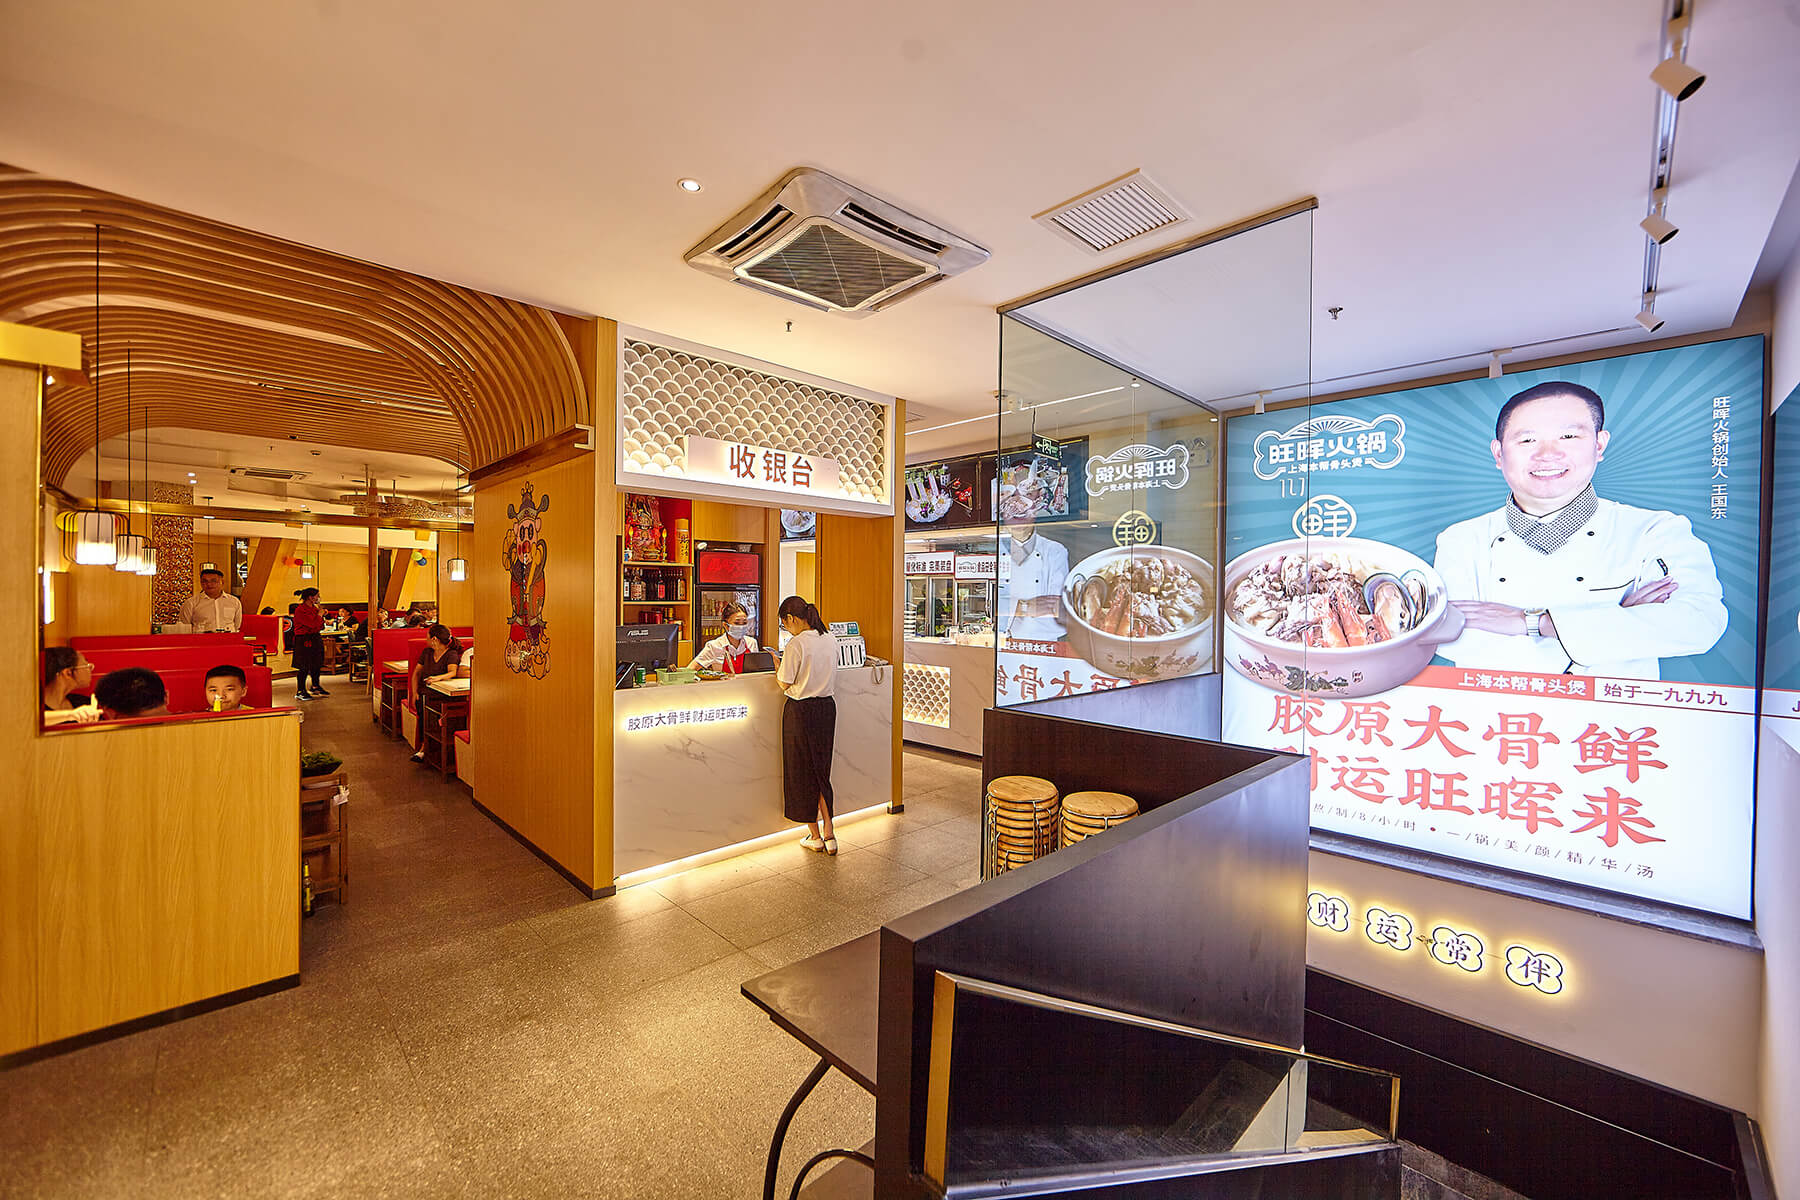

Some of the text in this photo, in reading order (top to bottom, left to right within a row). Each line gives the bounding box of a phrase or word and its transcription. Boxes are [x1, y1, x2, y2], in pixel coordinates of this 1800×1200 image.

[729, 445, 813, 488] 收银台
[1711, 396, 1730, 520] 旺晖火锅创始人 王国东
[1458, 672, 1586, 697] 上海本帮骨头煲
[1604, 683, 1728, 706] 始于一九九九
[627, 704, 748, 731] 胶原大骨鲜财运旺晖来
[1268, 694, 1668, 783] 胶原大骨鲜
